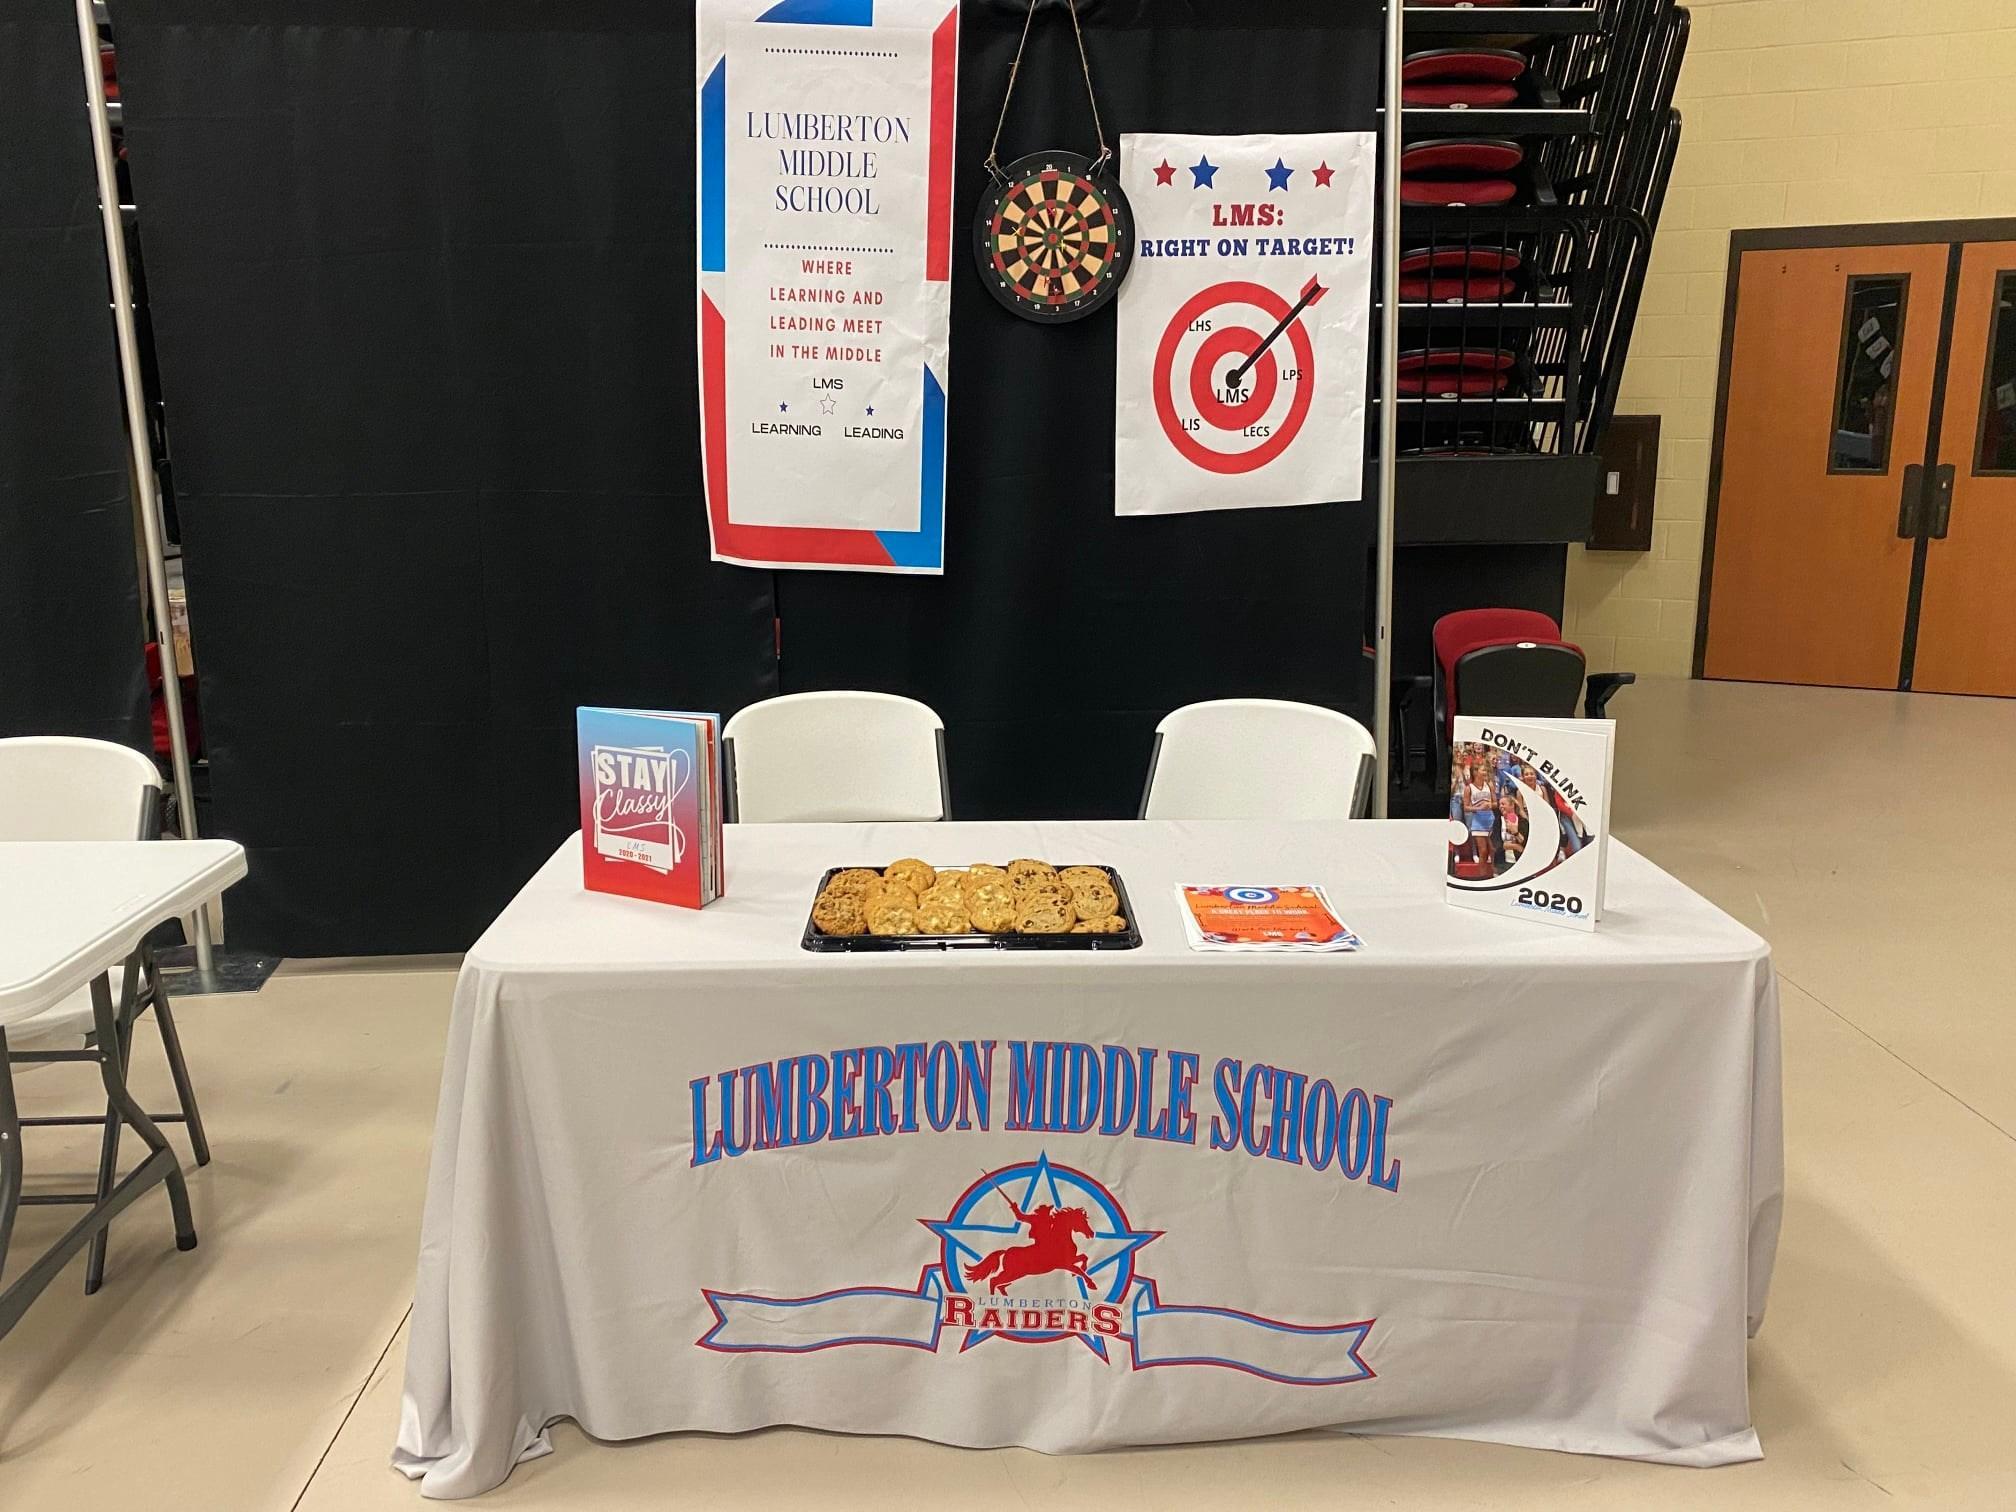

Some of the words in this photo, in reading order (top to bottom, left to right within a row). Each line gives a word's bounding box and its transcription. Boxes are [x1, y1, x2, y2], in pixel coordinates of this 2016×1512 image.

[747, 111, 911, 144] LUMBERTON
[778, 149, 879, 179] MIDDLE
[775, 184, 880, 215] SCHOOL
[1212, 203, 1284, 227] LMS:
[1141, 239, 1210, 257] RIGHT
[1217, 238, 1248, 257] ON
[1256, 237, 1355, 257] TARGET!
[801, 259, 852, 276] WHERE
[770, 287, 846, 304] LEARNING
[852, 290, 883, 305] AND
[770, 316, 836, 332] LEADING
[843, 319, 883, 334] MEET
[1188, 319, 1212, 333] LHS
[770, 344, 785, 359] IN
[792, 345, 819, 360] THE
[825, 347, 882, 363] MIDDLE
[813, 378, 844, 390] LMS
[1282, 369, 1304, 381] LPS
[1216, 388, 1250, 404] LMS
[752, 423, 822, 437] LEARNING
[844, 427, 904, 440] LEADING
[1181, 418, 1201, 432] LIS
[1243, 426, 1270, 438] LECS
[598, 752, 668, 793] STAY
[1481, 728, 1538, 762] DON'T
[1540, 760, 1587, 810] BLINK
[595, 788, 669, 822] Classy
[1517, 888, 1583, 914] 2020
[690, 1040, 996, 1168] LUMBERTON
[1006, 1040, 1199, 1145] MIDDLE
[1209, 1057, 1401, 1193] SCHOOL
[978, 1296, 1092, 1311] LUMBERTON
[944, 1296, 1122, 1336] RAIDERS
